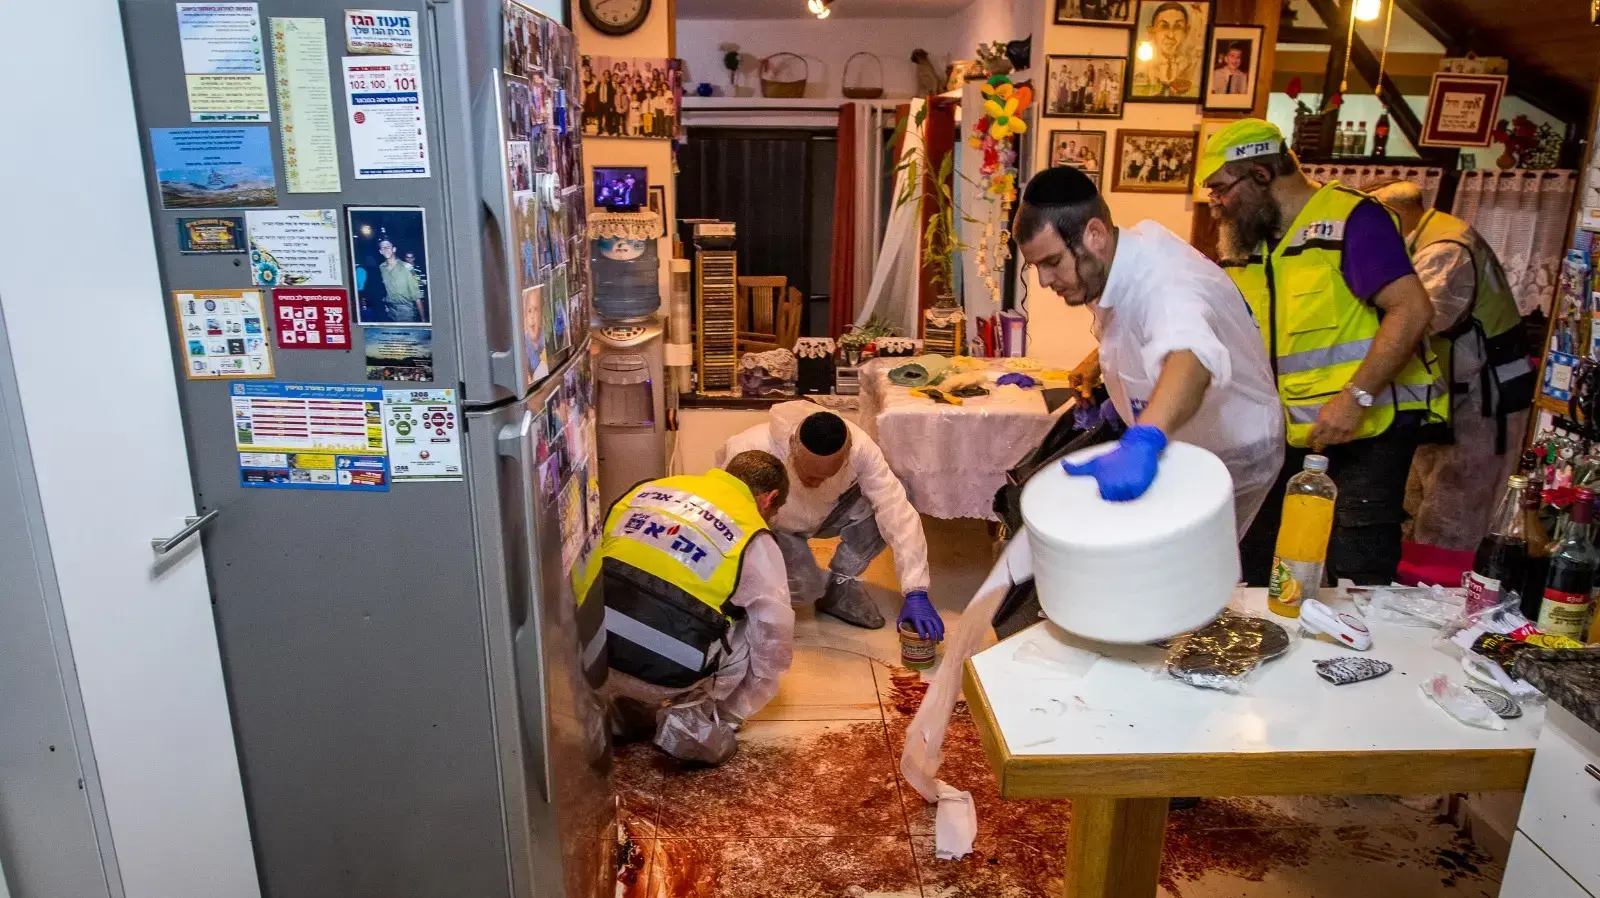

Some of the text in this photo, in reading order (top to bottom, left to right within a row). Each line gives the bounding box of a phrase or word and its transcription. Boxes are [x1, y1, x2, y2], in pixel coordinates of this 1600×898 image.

[350, 15, 410, 27] מעוז הגז
[352, 26, 369, 36] שלך
[350, 78, 416, 90] 101 100 102
[1236, 142, 1270, 156] זק"א
